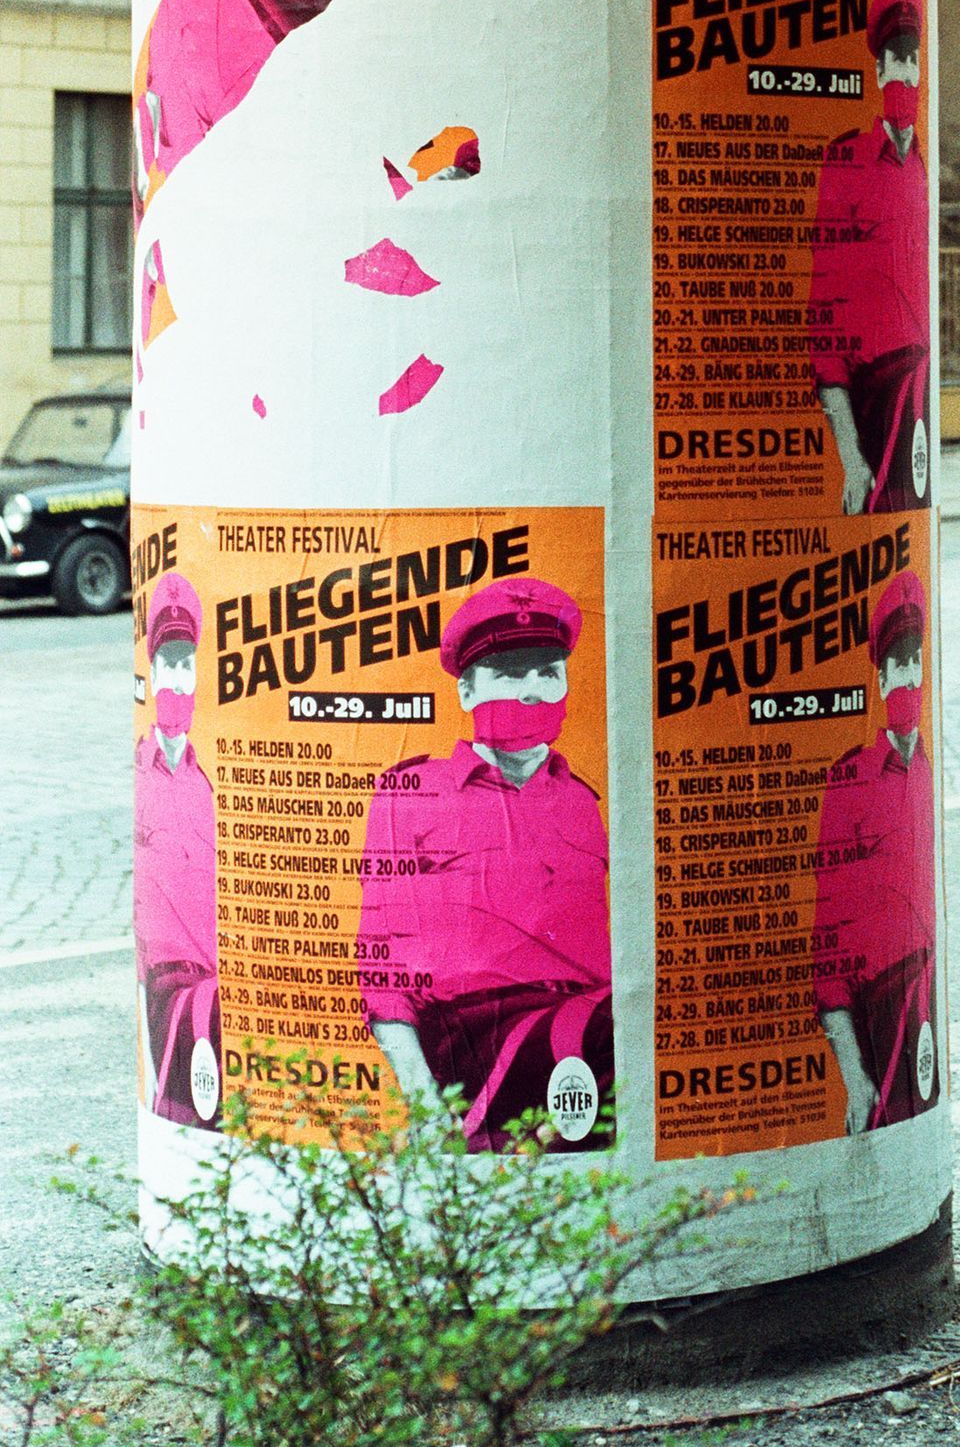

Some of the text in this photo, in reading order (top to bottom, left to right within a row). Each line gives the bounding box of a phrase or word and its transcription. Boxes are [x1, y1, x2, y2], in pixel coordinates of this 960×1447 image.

[748, 70, 861, 94] 10.-29. Juli
[700, 114, 752, 131] HELDEN
[756, 115, 789, 132] 20.00
[654, 142, 671, 158] 17.
[676, 141, 721, 159] NEUES
[725, 143, 751, 160] AUS
[755, 144, 778, 160] DER
[654, 169, 672, 186] 18.
[678, 170, 706, 186] DAS
[784, 171, 816, 188] 20.00
[654, 197, 805, 215] 18. CRISPERANTO 23.00
[654, 225, 672, 242] 19.
[678, 225, 721, 242] HELGE
[725, 226, 793, 243] SCHNEIDER
[797, 226, 821, 243] LIVE
[654, 253, 786, 270] 19. BUKOWSKI 23.00
[654, 281, 675, 298] 20.
[680, 281, 725, 298] TAUBE
[759, 281, 793, 298] 20.00
[657, 427, 823, 460] DRESDEN
[218, 525, 381, 553] THEATER FESTIVAL
[657, 527, 830, 560] THEATER FESTIVAL
[216, 525, 529, 652] FLIEGENDE
[656, 522, 910, 664] FLIEGENDE
[218, 600, 441, 705] BAUTEN
[657, 597, 869, 718] BAUTEN
[289, 696, 431, 719] 10.-29. Juli
[750, 689, 864, 718] 10.-29. Juli
[250, 740, 293, 758] HELDEN
[297, 742, 332, 760] 20.00
[703, 746, 755, 764] HELDEN
[758, 743, 792, 760] 20.00
[217, 766, 420, 790] 17. NEUES AUS DER DaDaeR 20.00
[655, 779, 673, 796] 17.
[678, 777, 723, 795] NEUES
[727, 773, 754, 791] AUS
[758, 772, 781, 790] DER
[217, 794, 230, 811] 18.
[233, 795, 253, 812] DAS
[257, 793, 323, 816] MÄUSCHEN
[327, 800, 364, 818] 20.00
[656, 807, 675, 824] 18.
[680, 805, 708, 824] DAS
[787, 797, 818, 815] 20.00
[217, 822, 350, 846] 18. CRISPERANTO 23.00
[656, 836, 675, 853] 18.
[680, 828, 773, 852] CRISPERANTO
[776, 825, 807, 843] 23.00
[217, 849, 230, 866] 19.
[234, 851, 266, 869] HELGE
[270, 853, 337, 874] SCHNEIDER
[343, 858, 372, 875] LIVE
[376, 859, 416, 876] 20.00
[656, 865, 676, 882] 19.
[681, 861, 724, 879] HELGE
[729, 856, 797, 877] SCHNEIDER
[800, 852, 825, 870] LIVE
[217, 878, 330, 901] 19. BUKOWSKI 23.00
[657, 893, 676, 910] 19.
[681, 887, 754, 908] BUKOWSKI
[757, 883, 790, 901] 23.00
[218, 904, 231, 921] 20.
[235, 907, 270, 926] TAUBE
[303, 911, 339, 930] 20.00
[657, 921, 678, 938] 20.
[683, 917, 730, 936] TAUBE
[764, 911, 798, 929] 20.00
[251, 935, 289, 955] UNTER
[294, 940, 349, 958] PALMEN
[353, 942, 390, 960] 23.00
[705, 943, 752, 963] UNTER
[756, 937, 807, 959] PALMEN
[251, 963, 323, 984] GNADENLOS
[328, 969, 389, 988] DEUTSCH
[393, 972, 433, 989] 20.00
[703, 967, 782, 990] GNADENLOS
[786, 959, 836, 981] DEUTSCH
[256, 987, 288, 1009] BÄNG
[291, 990, 326, 1012] BÄNG
[330, 997, 368, 1014] 20.00
[706, 999, 744, 1019] BÄNG
[749, 994, 782, 1015] BÄNG
[786, 992, 817, 1009] 20.00
[256, 1017, 275, 1035] DIE
[334, 1024, 369, 1041] 23.00
[704, 1028, 727, 1047] DIE
[788, 1017, 818, 1035] 23.00
[225, 1049, 380, 1092] DRESDEN
[659, 1053, 826, 1099] DRESDEN
[553, 1091, 592, 1112] JEVER
